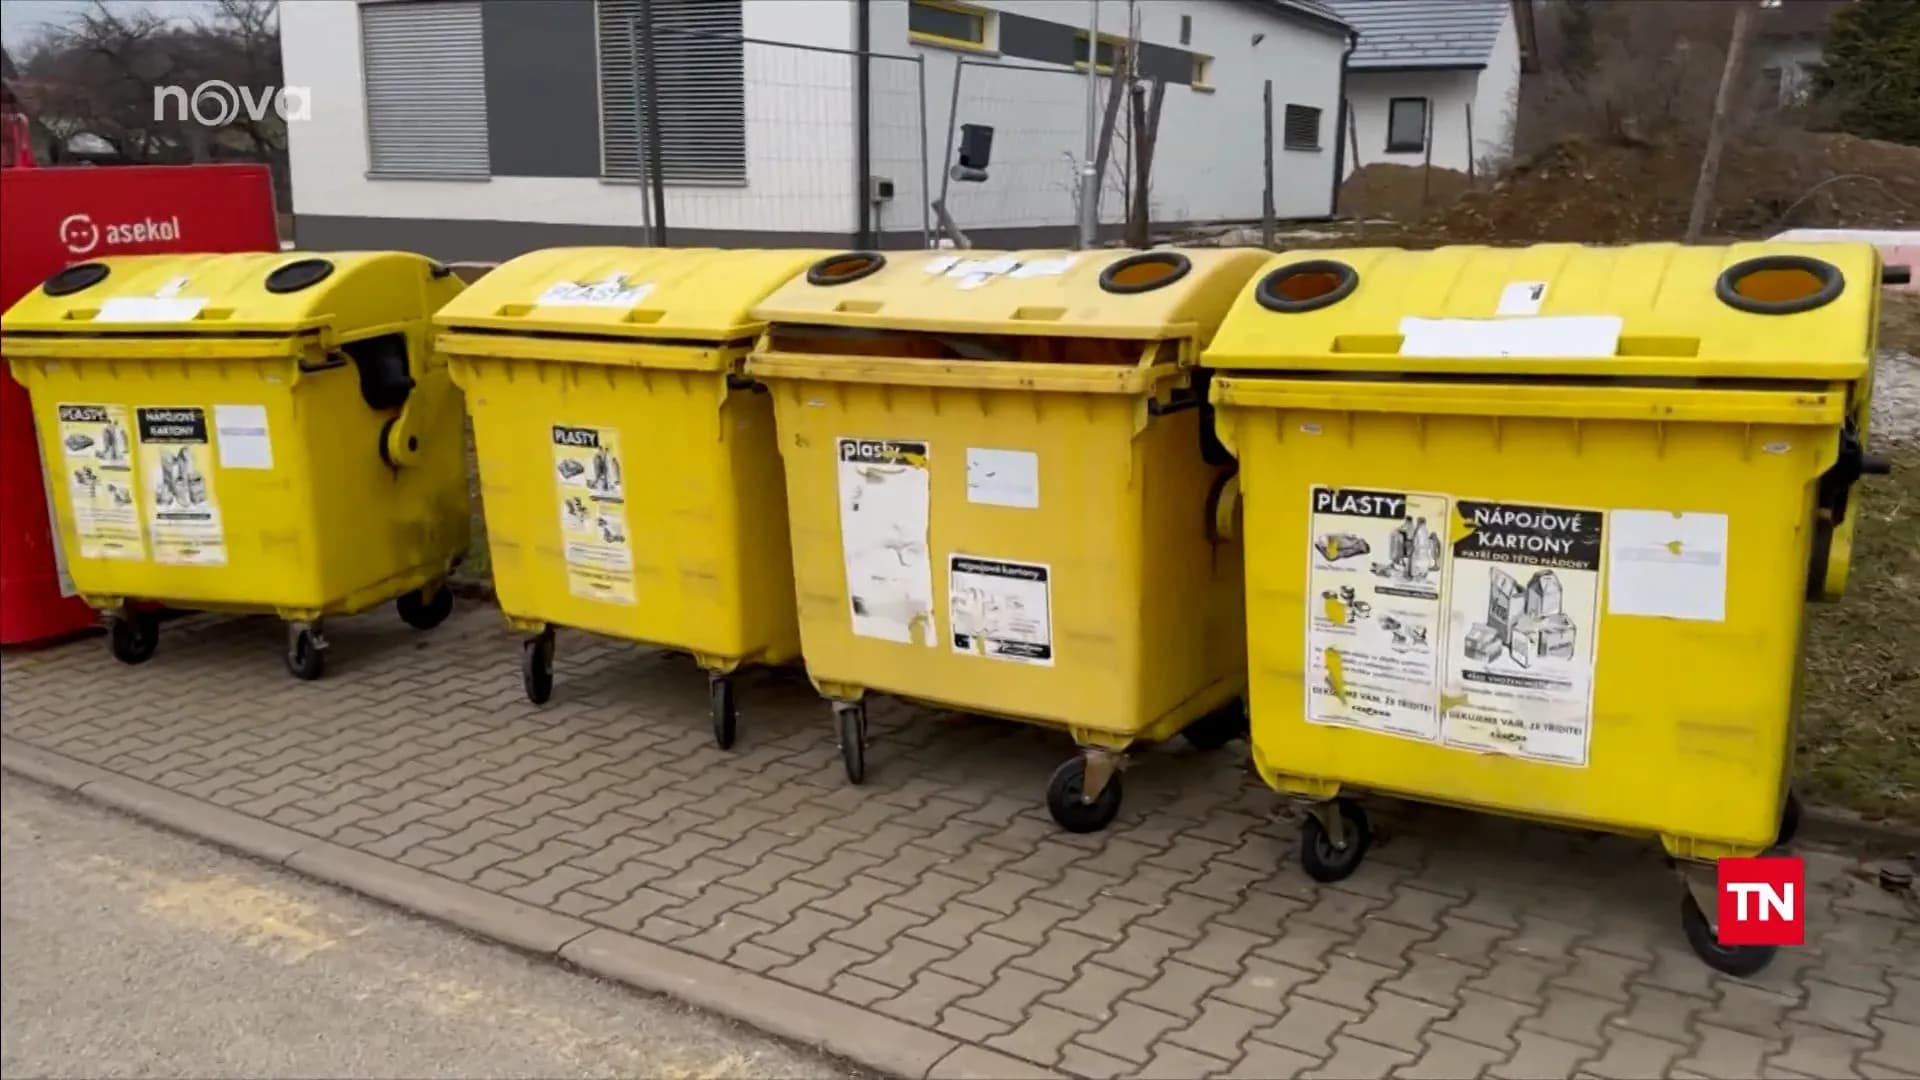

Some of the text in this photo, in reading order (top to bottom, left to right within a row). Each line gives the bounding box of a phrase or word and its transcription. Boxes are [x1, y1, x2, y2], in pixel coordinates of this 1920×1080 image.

[105, 215, 181, 245] asekol
[554, 428, 597, 447] PLASTY
[842, 440, 902, 464] plasty
[1317, 492, 1401, 517] PLASTY
[1473, 507, 1582, 533] NÁPOJOVÉ
[1477, 531, 1575, 555] KARTONY
[1461, 549, 1491, 561] PATŘÍ
[1492, 552, 1511, 563] DO
